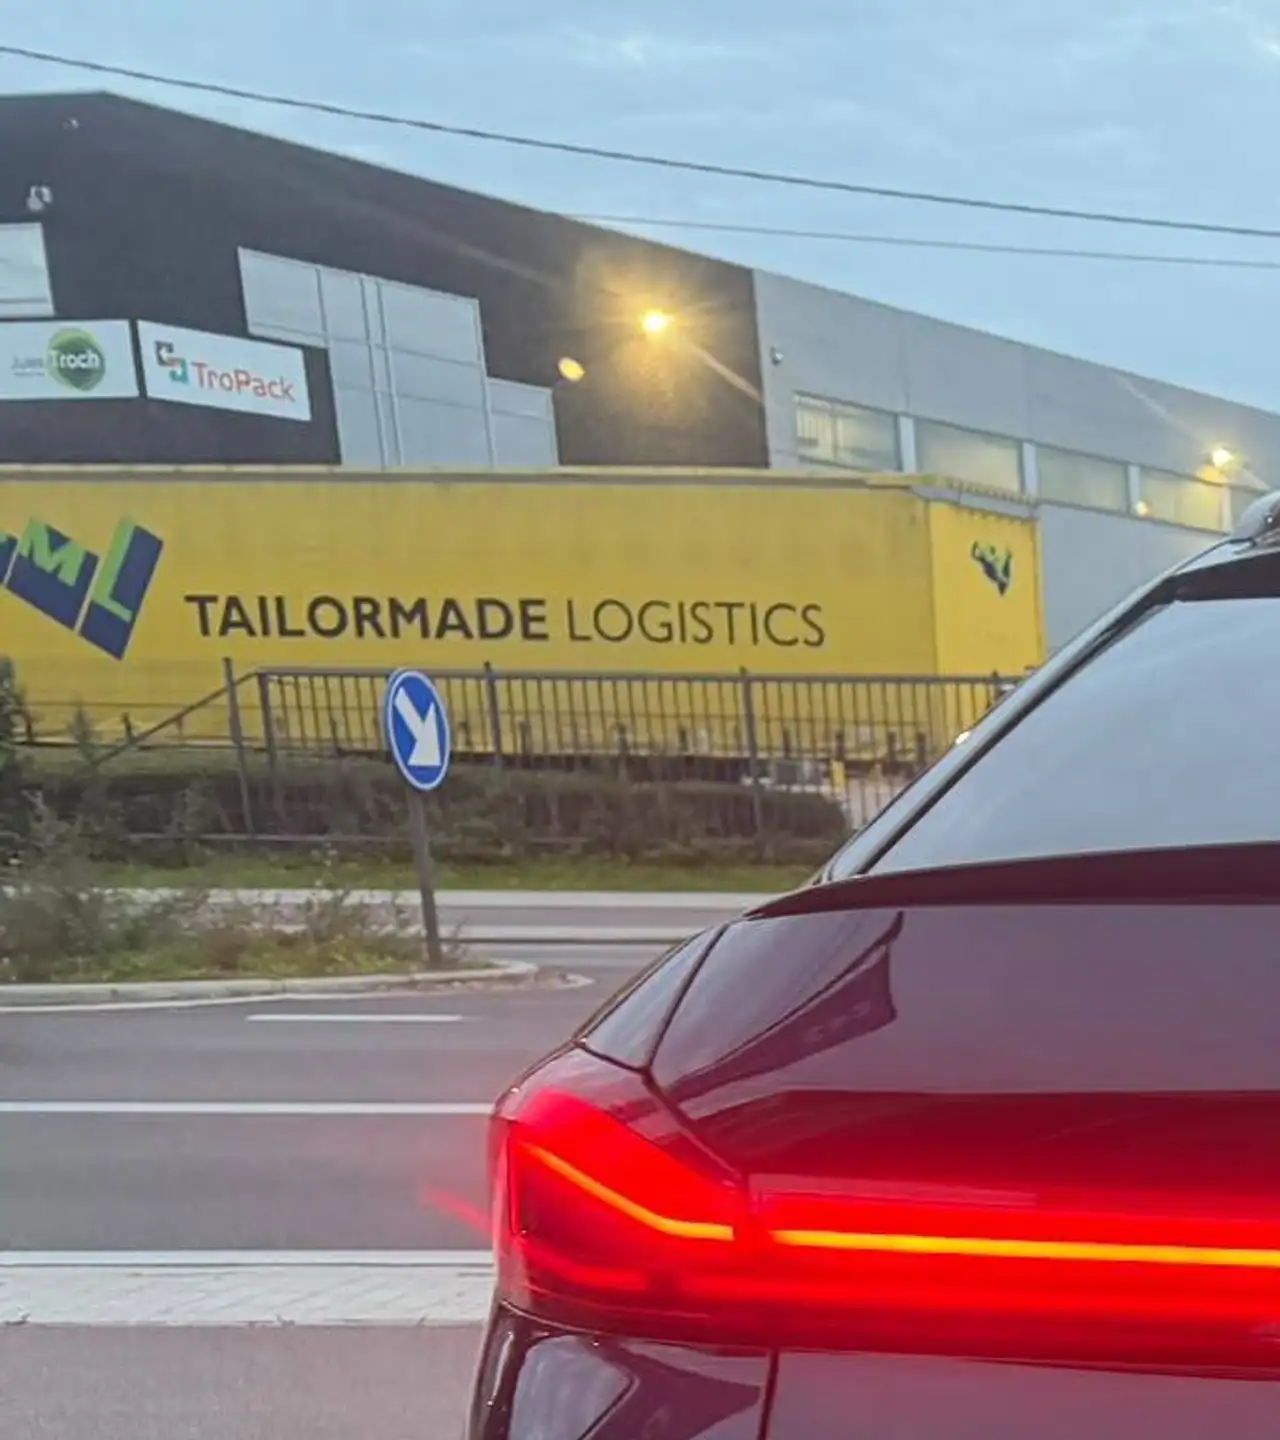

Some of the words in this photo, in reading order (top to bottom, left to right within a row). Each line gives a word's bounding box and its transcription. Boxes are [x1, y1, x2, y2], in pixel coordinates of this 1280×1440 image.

[49, 349, 100, 369] Troch
[191, 361, 295, 401] TroPack
[0, 515, 135, 625] ML
[183, 594, 550, 641] TAILORMADE
[566, 600, 826, 648] LOGISTICS
